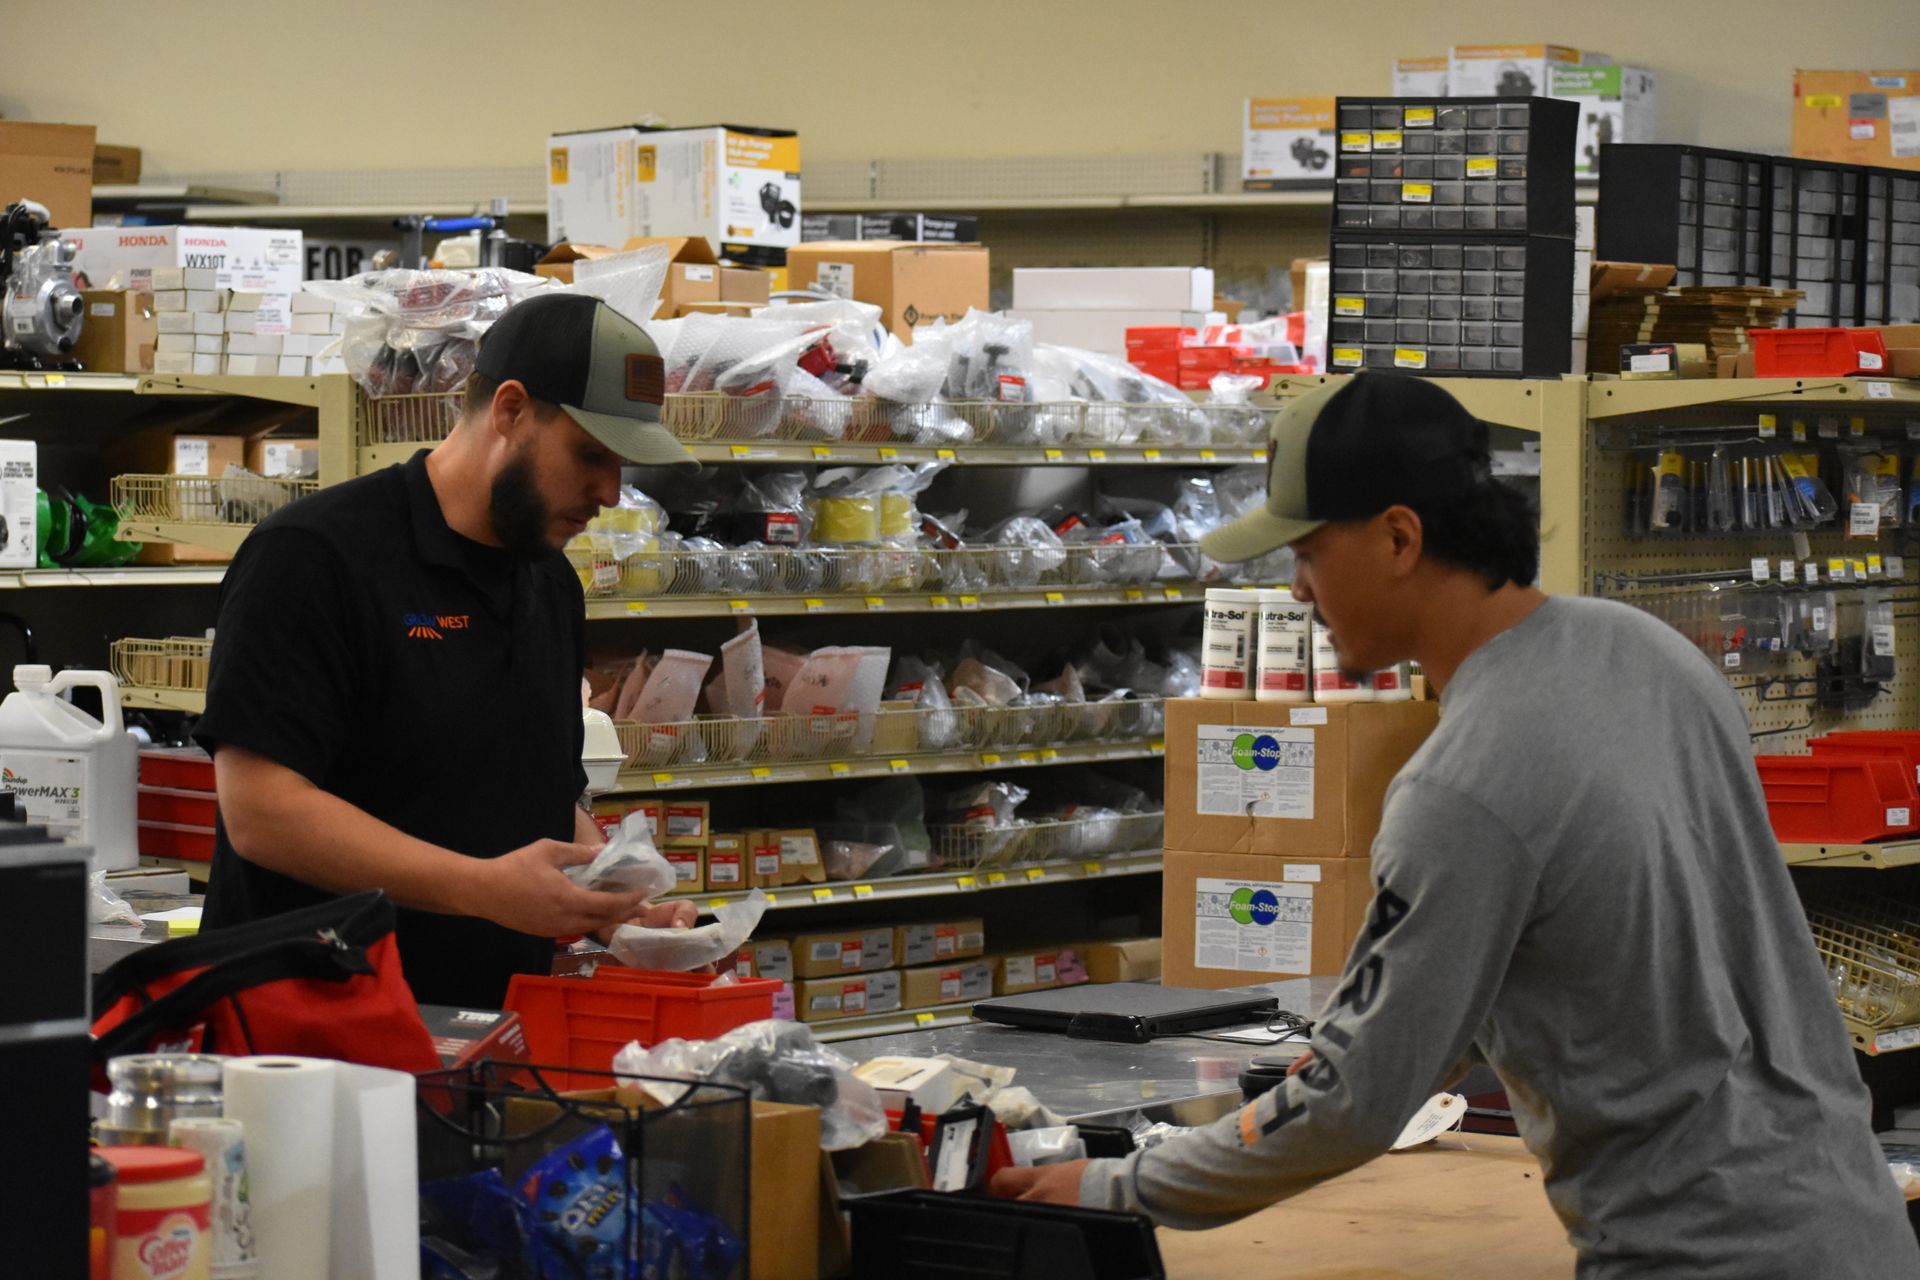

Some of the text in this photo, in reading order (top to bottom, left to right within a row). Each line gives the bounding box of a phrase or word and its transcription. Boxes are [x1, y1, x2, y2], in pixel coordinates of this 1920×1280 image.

[118, 235, 168, 247] HONDA
[185, 238, 227, 247] HONDA
[185, 254, 226, 269] WX10T
[307, 246, 363, 281] FOR
[436, 615, 470, 629] WEST
[1204, 609, 1245, 621] tra-Sol
[1232, 746, 1281, 760] Foam-Stop
[5, 784, 80, 798] PowerMAX 3
[1230, 901, 1280, 915] Foam-Stop
